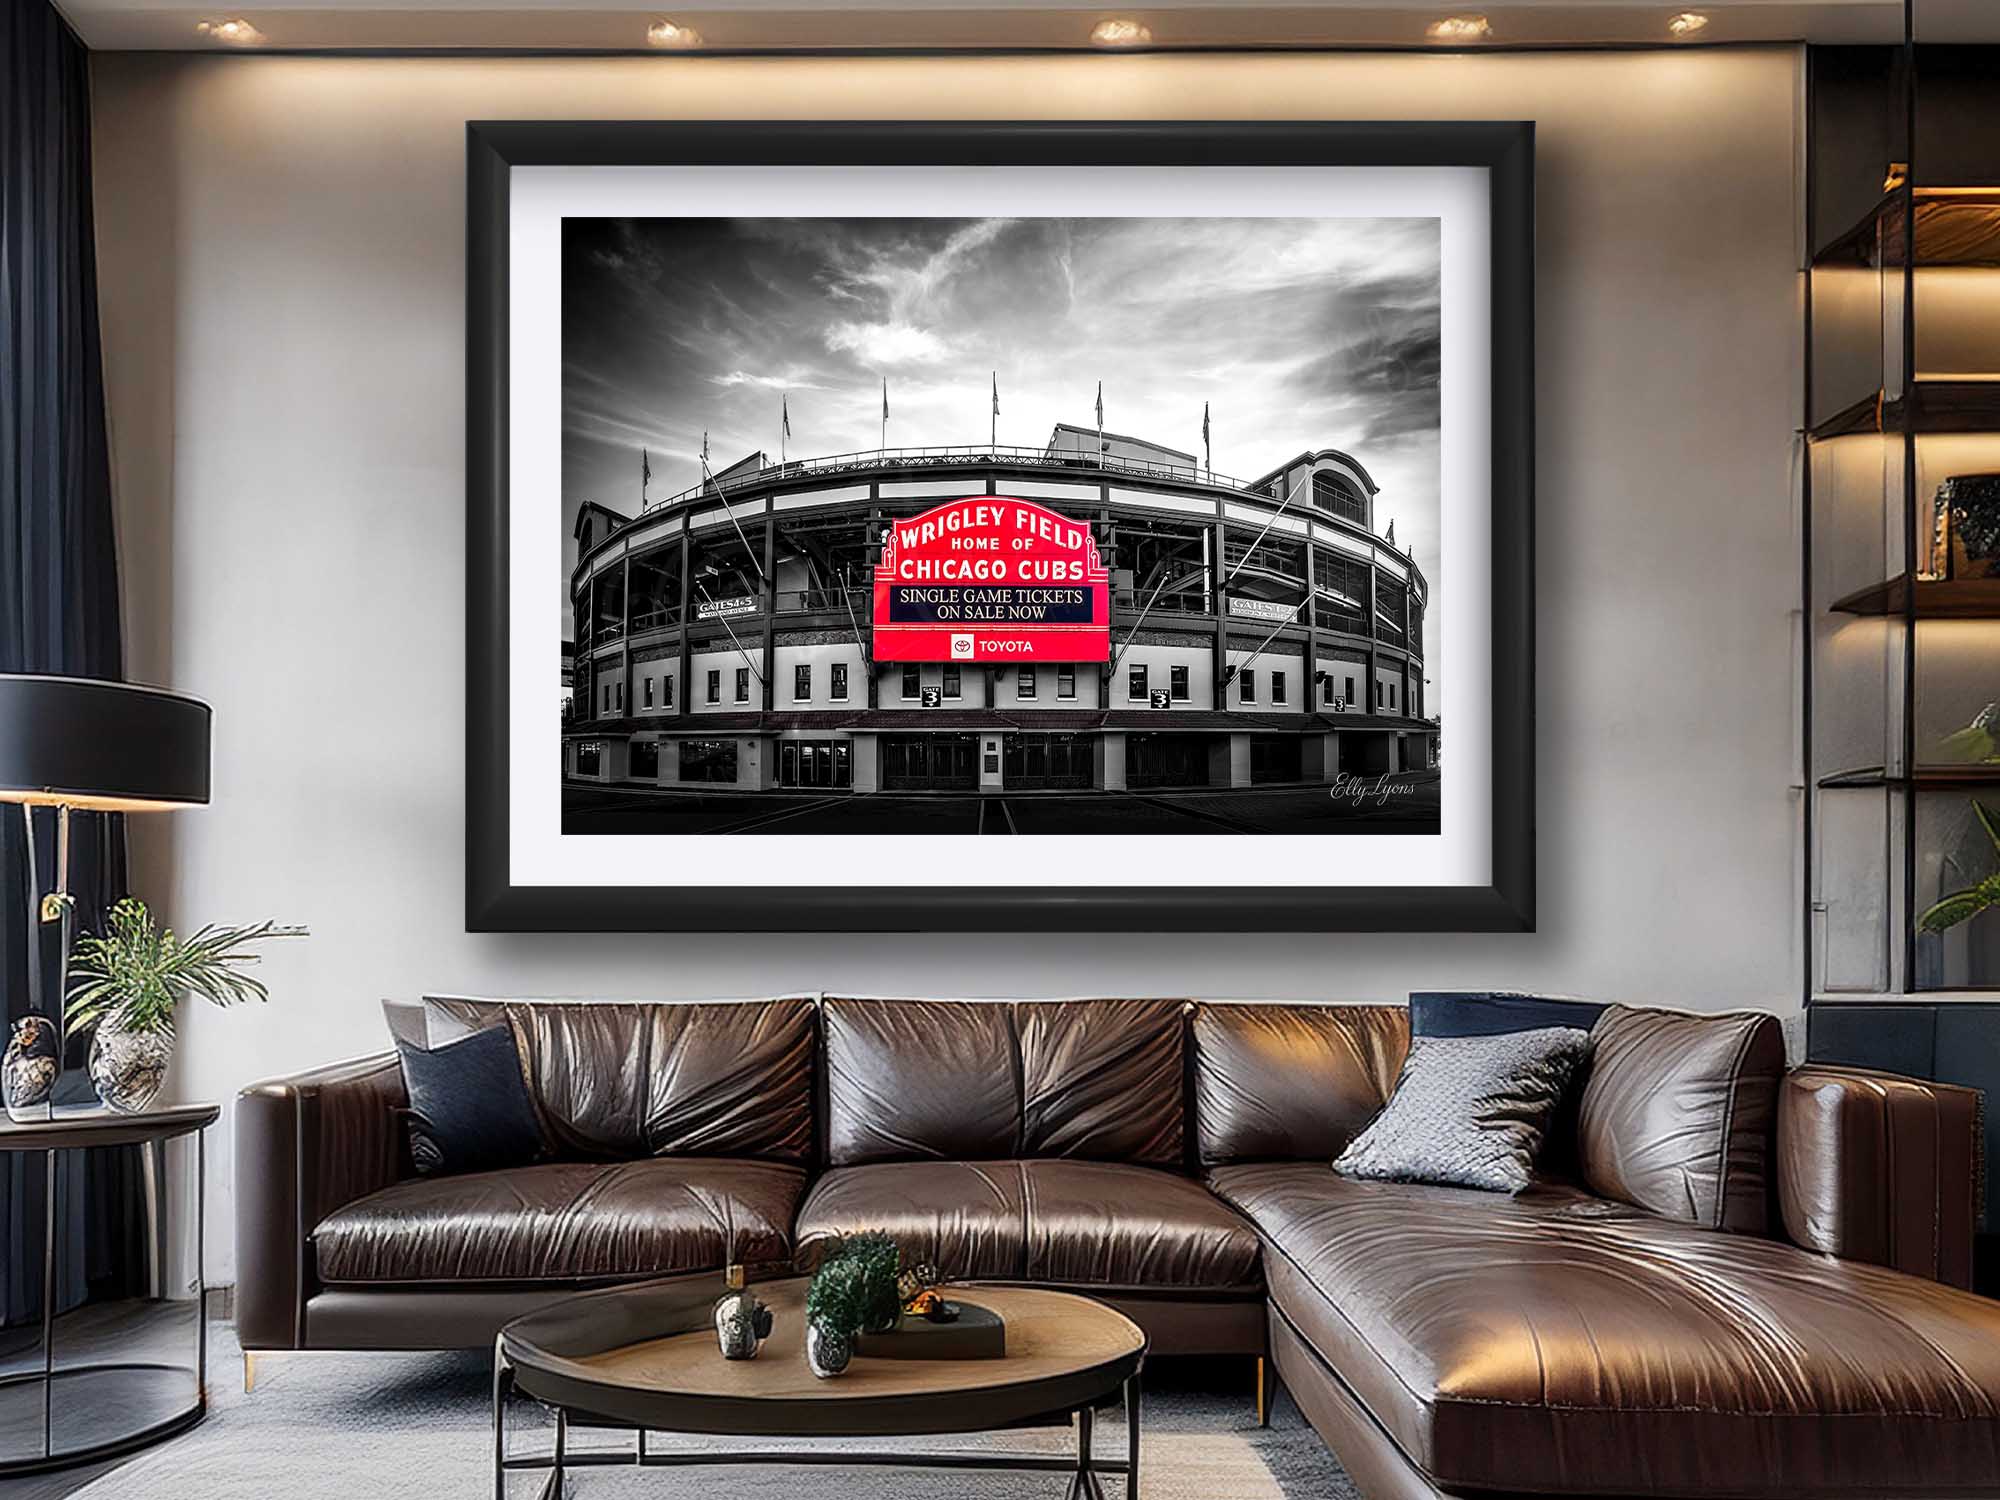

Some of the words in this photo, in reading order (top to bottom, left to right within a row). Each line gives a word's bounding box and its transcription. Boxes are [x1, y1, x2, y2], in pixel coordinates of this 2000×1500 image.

[901, 506, 1005, 549] WRIGLEY
[1016, 509, 1083, 551] FIELD
[952, 538, 1000, 550] HOME
[1012, 538, 1034, 550] OF
[900, 559, 1007, 580] CHICAGO
[1018, 560, 1084, 580] CUBS
[900, 589, 960, 603] SINGLE
[963, 589, 1012, 603] GAME
[1015, 589, 1083, 604] TICKETS
[700, 600, 733, 612] GATES
[937, 605, 961, 619] ON
[964, 605, 1004, 619] SALE
[1008, 605, 1046, 619] NOW
[979, 641, 1033, 652] TOYOTA
[925, 692, 938, 704] 3
[1154, 693, 1166, 705] 3
